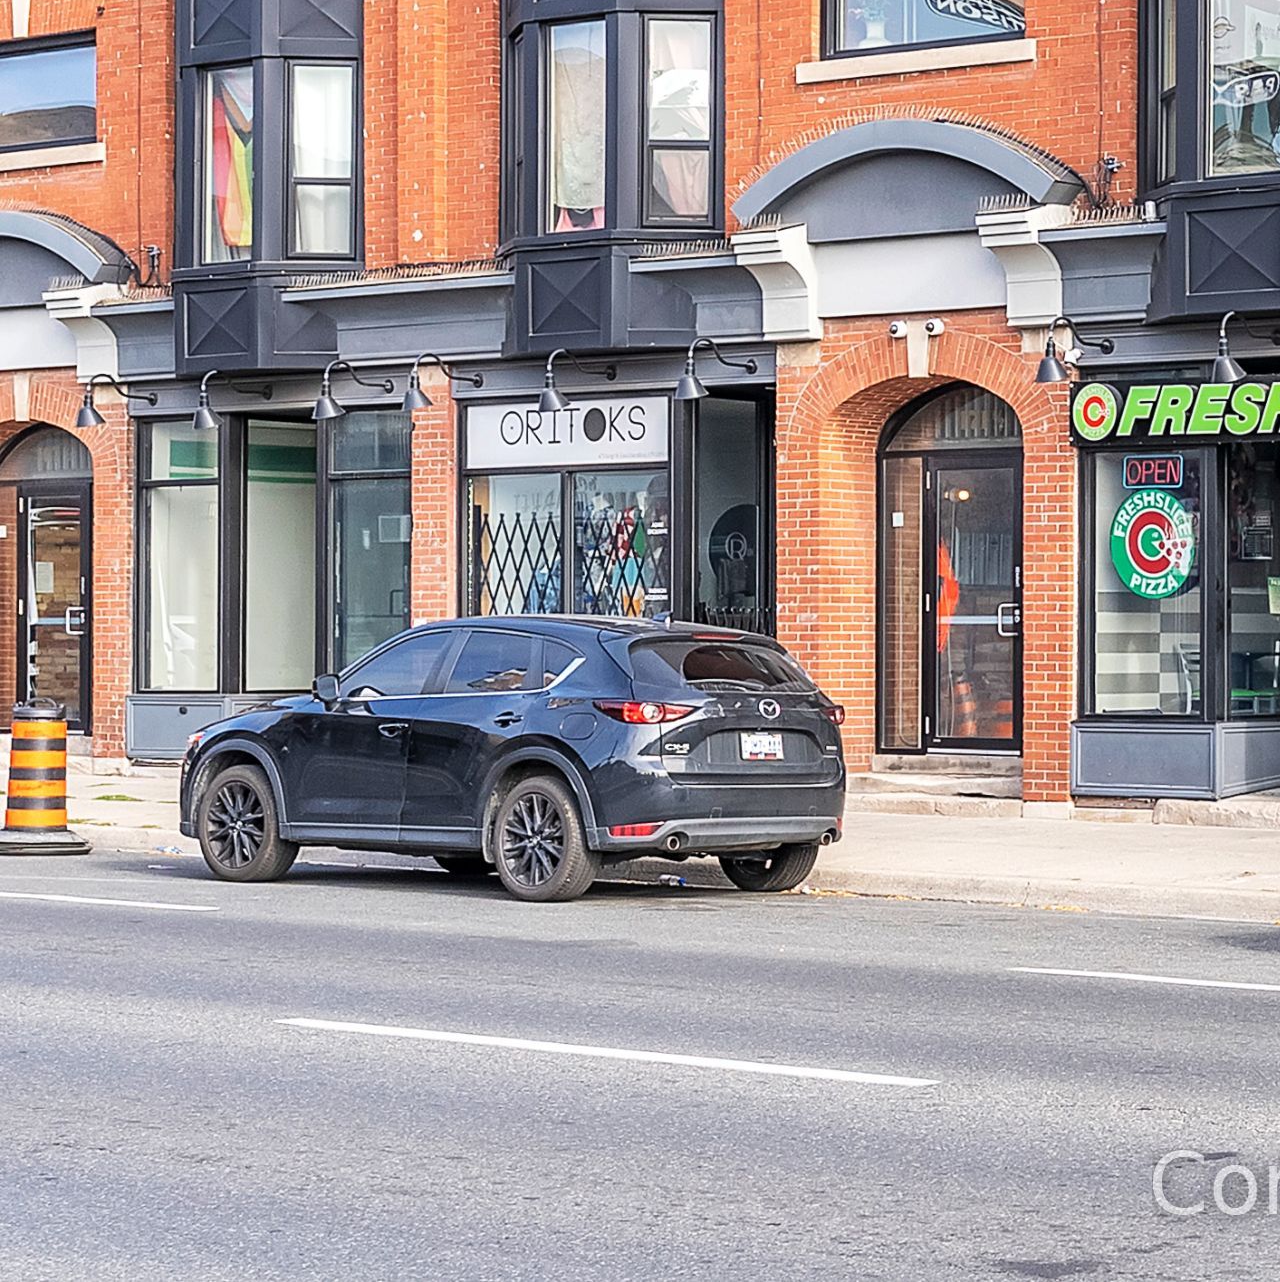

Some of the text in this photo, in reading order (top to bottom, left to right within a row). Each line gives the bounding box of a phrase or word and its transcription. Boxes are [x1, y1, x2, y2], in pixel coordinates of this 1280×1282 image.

[500, 405, 646, 445] ORITOKS
[1127, 460, 1180, 484] OPEN
[1113, 492, 1191, 537] FRESHSLICE
[1129, 573, 1178, 594] PIZZA
